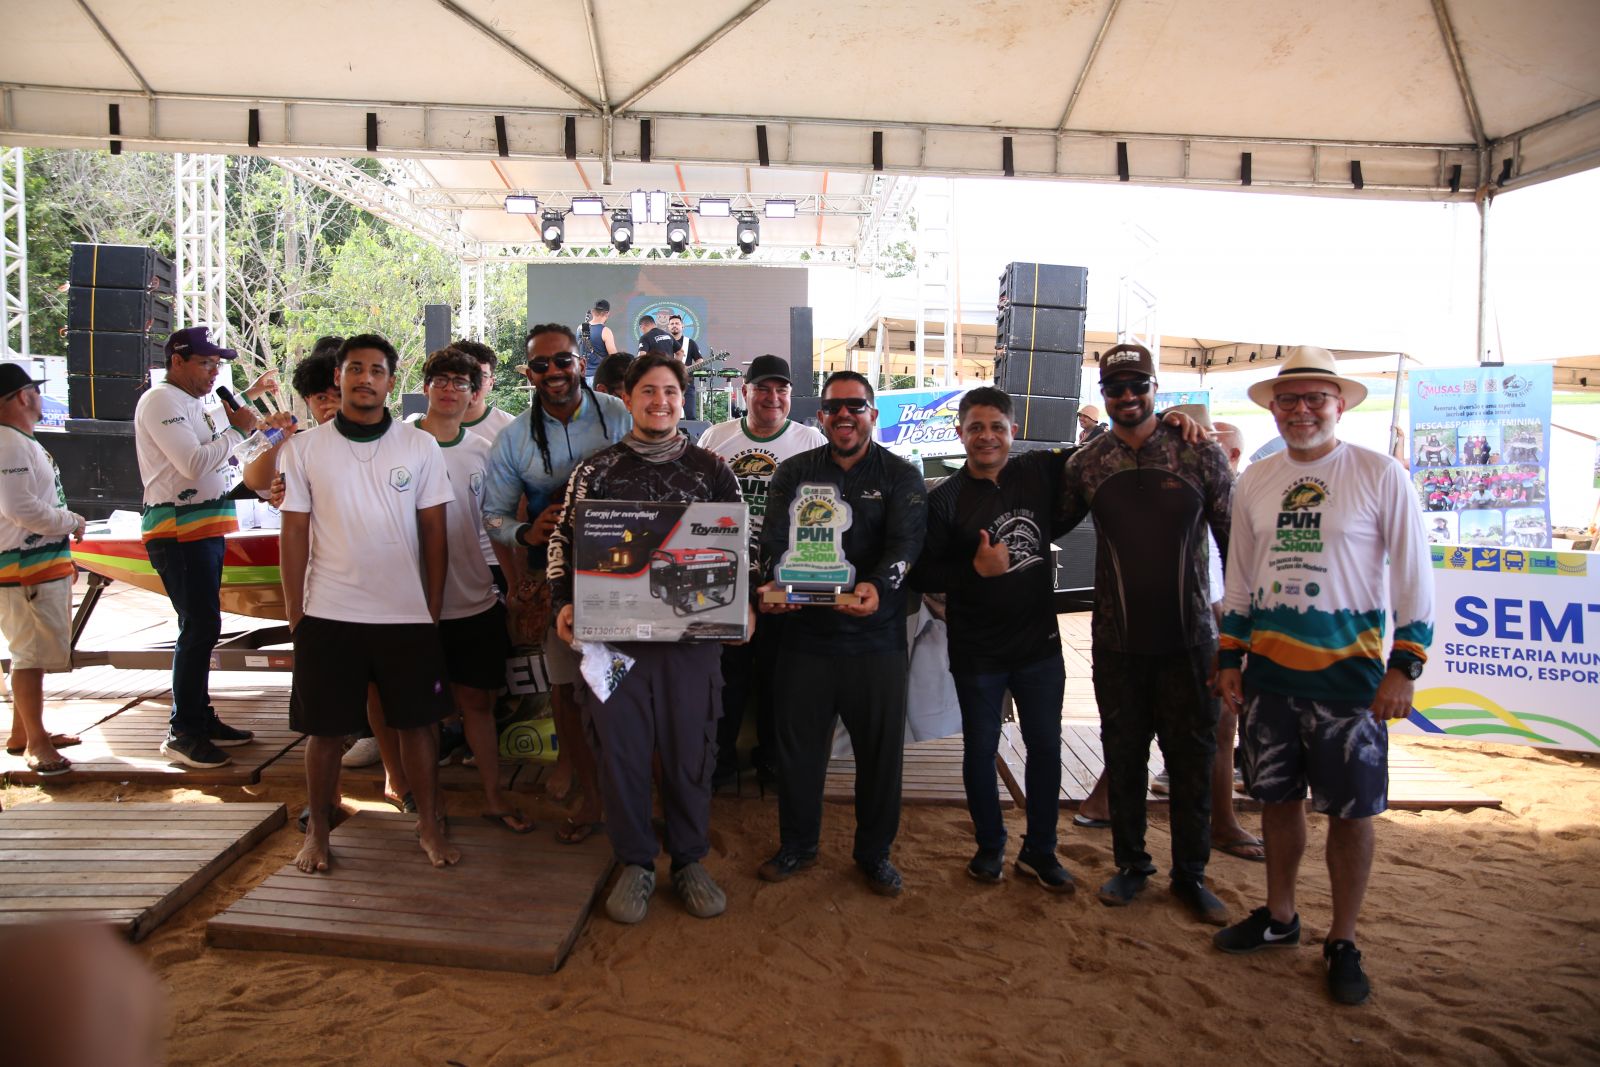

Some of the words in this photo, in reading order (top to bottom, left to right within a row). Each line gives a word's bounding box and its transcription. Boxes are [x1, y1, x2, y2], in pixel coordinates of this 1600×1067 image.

[1425, 384, 1461, 396] MUSAS
[1497, 417, 1542, 427] FEMININA
[894, 423, 961, 446] Pesca
[734, 448, 779, 463] FESTIVAL
[800, 494, 835, 509] FESTIVAL
[584, 509, 609, 520] Energy
[609, 510, 621, 520] for
[621, 510, 659, 521] everything!
[1276, 512, 1322, 529] PVH
[690, 522, 740, 536] Toyama
[796, 527, 834, 542] PVH
[1276, 529, 1321, 542] PESCA
[796, 542, 835, 552] PESCA
[1281, 539, 1324, 553] SHOW
[800, 551, 838, 563] SHOW
[1444, 643, 1557, 664] SECRETARIA
[1444, 660, 1534, 682] TURISMO,
[1538, 667, 1600, 684] ESPOR
